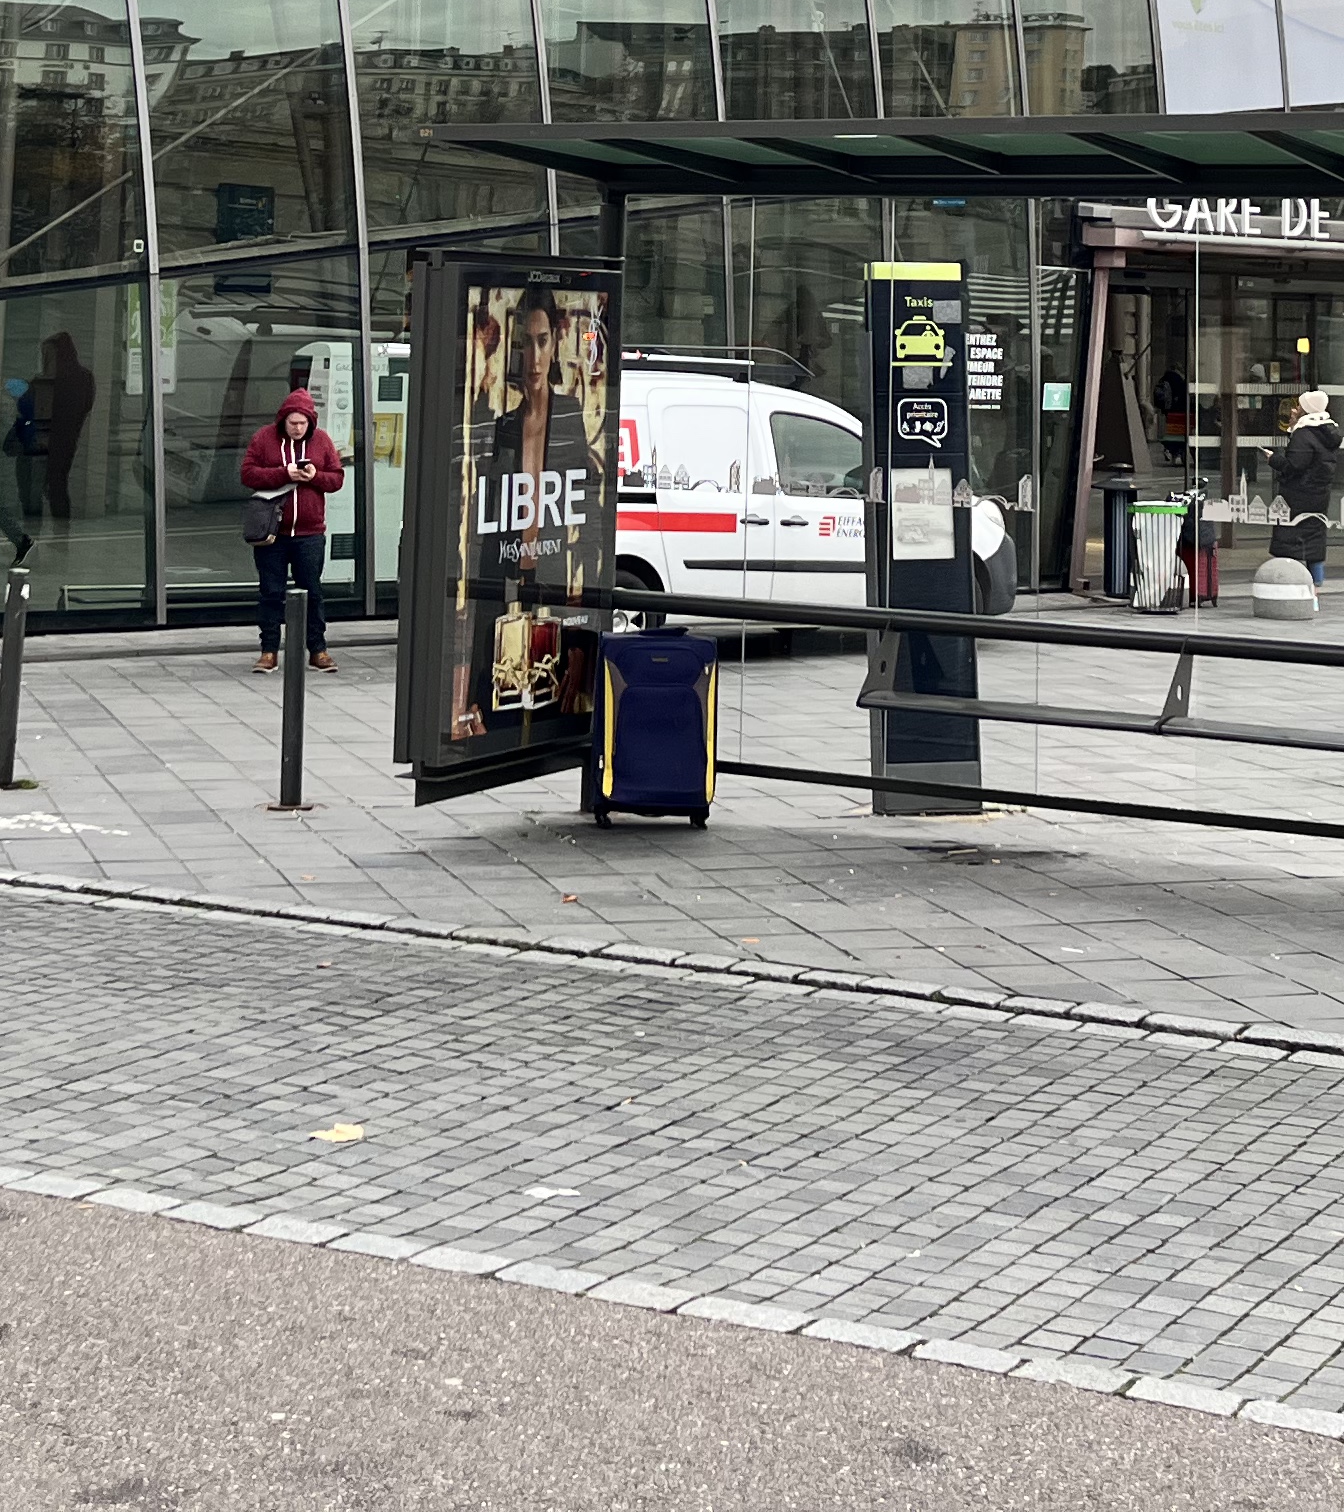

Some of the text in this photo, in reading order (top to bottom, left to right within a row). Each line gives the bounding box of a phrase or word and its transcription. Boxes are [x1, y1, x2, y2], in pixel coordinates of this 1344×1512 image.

[1146, 197, 1263, 236] GARE
[1280, 197, 1331, 239] DE
[904, 296, 934, 309] Taxis
[969, 347, 1005, 361] ESPACE
[969, 388, 1003, 402] ARETTE
[476, 468, 588, 535] LIBRE
